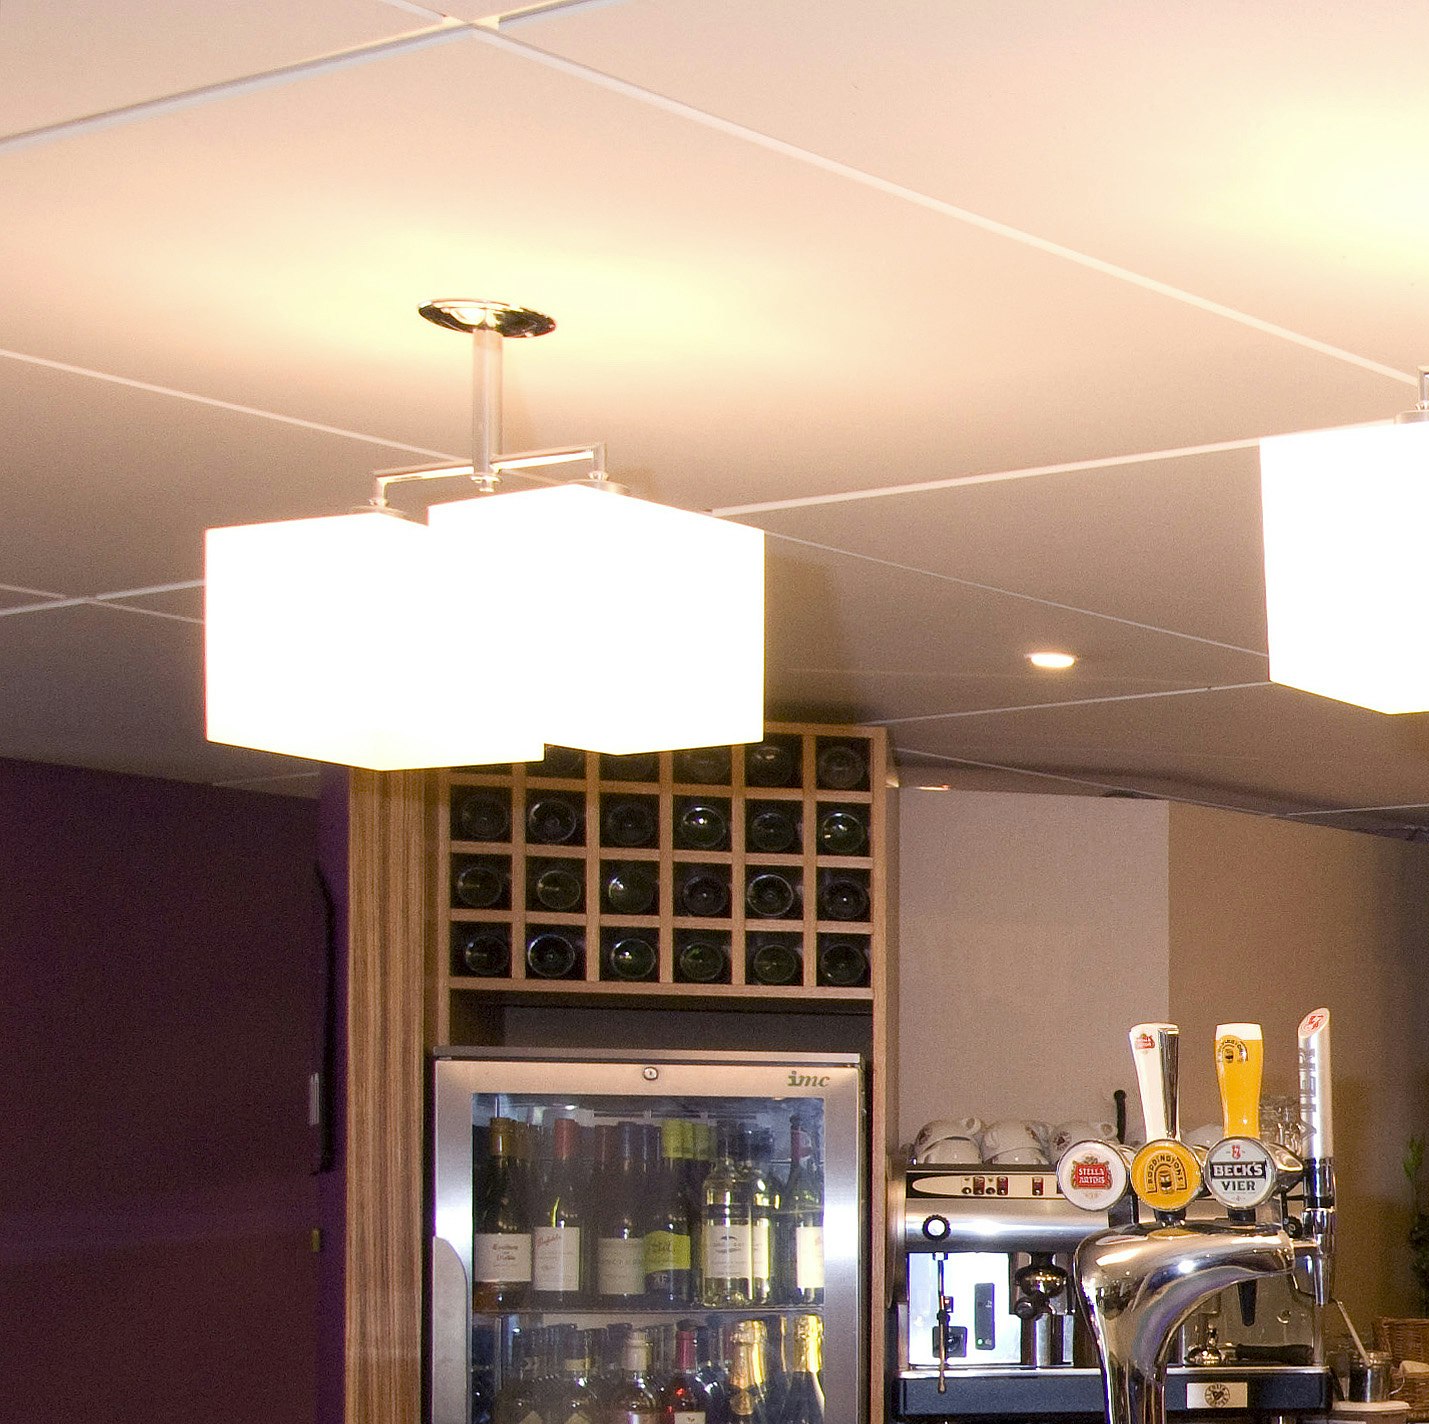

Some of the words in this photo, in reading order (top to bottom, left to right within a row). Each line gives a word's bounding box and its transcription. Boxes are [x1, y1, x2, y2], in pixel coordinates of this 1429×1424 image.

[787, 1070, 831, 1088] imc
[1079, 1167, 1105, 1176] STELLA
[1212, 1163, 1263, 1177] BECK'S
[1079, 1176, 1105, 1184] ARTOIS
[1221, 1180, 1256, 1191] VIER
